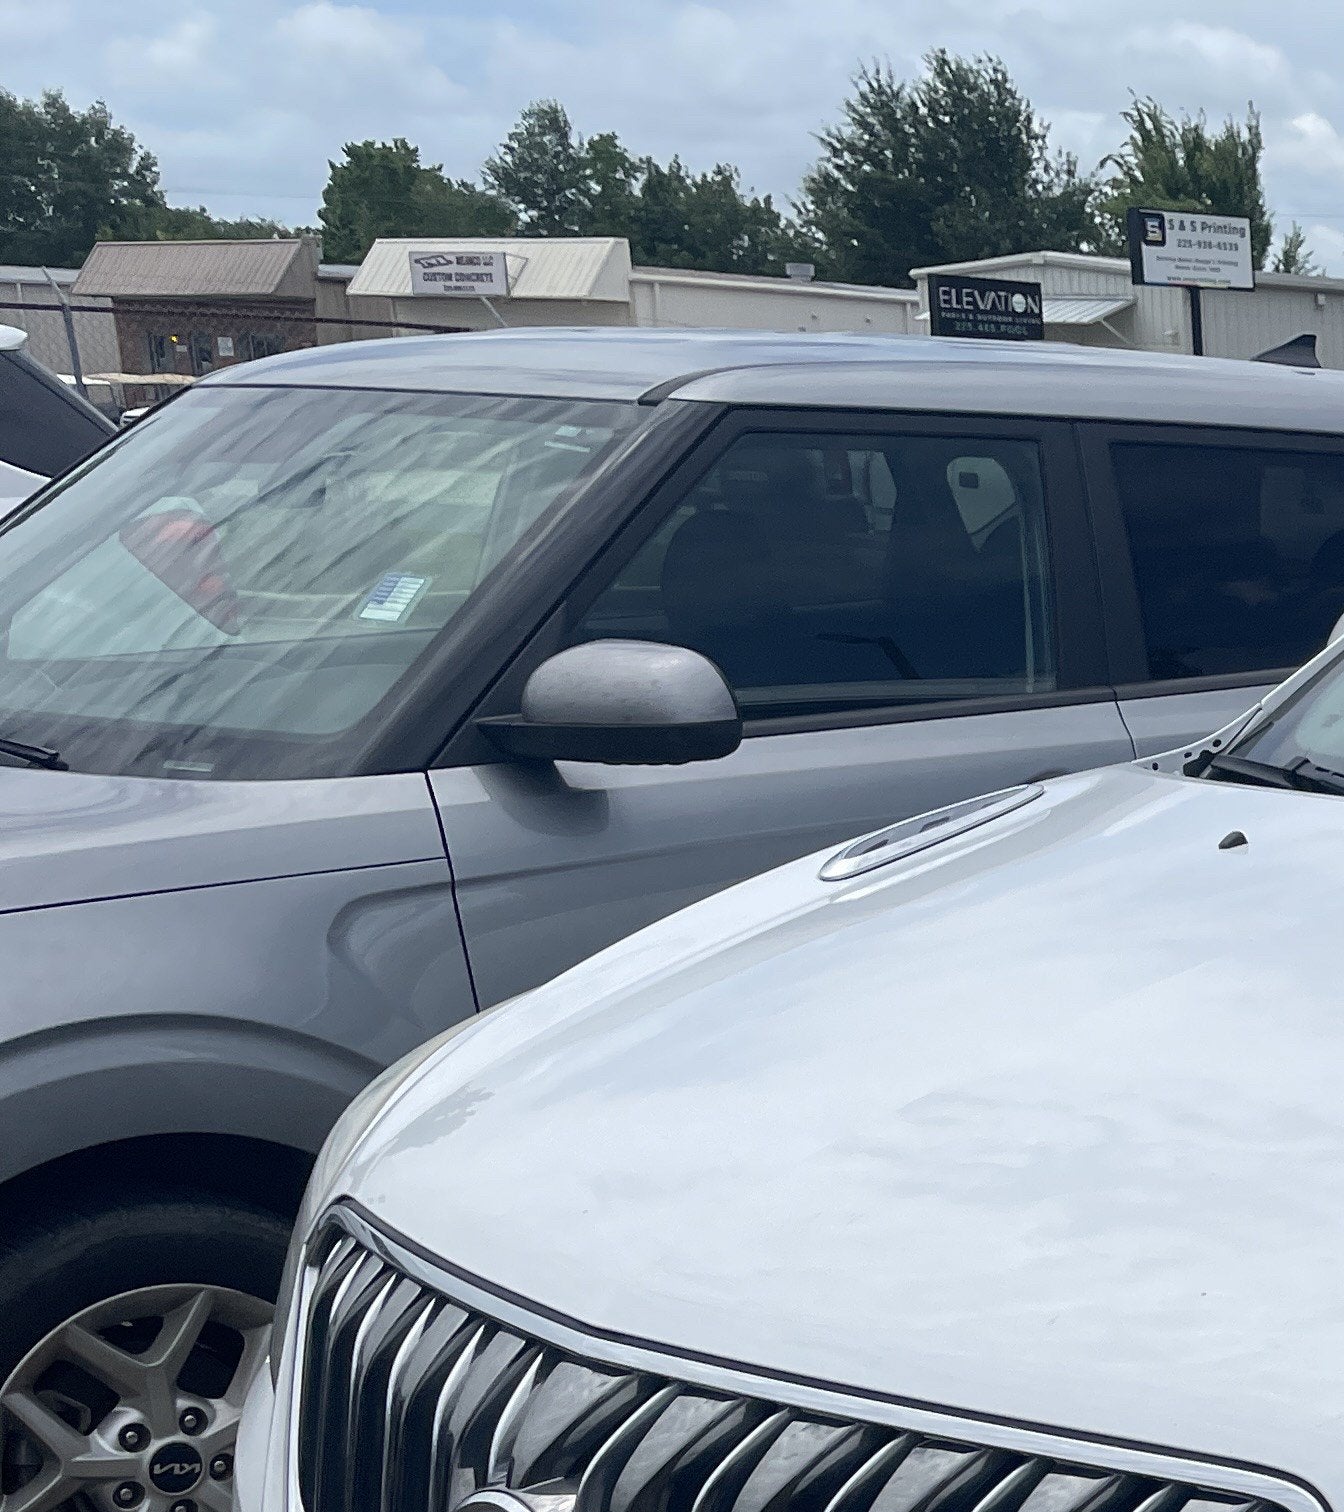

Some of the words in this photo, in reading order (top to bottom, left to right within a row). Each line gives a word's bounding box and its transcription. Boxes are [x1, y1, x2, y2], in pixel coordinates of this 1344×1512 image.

[1167, 218, 1176, 231] S
[1178, 219, 1187, 231] &
[1189, 220, 1198, 232] S
[1200, 221, 1247, 239] Printing
[938, 286, 1041, 315] ELEVATION
